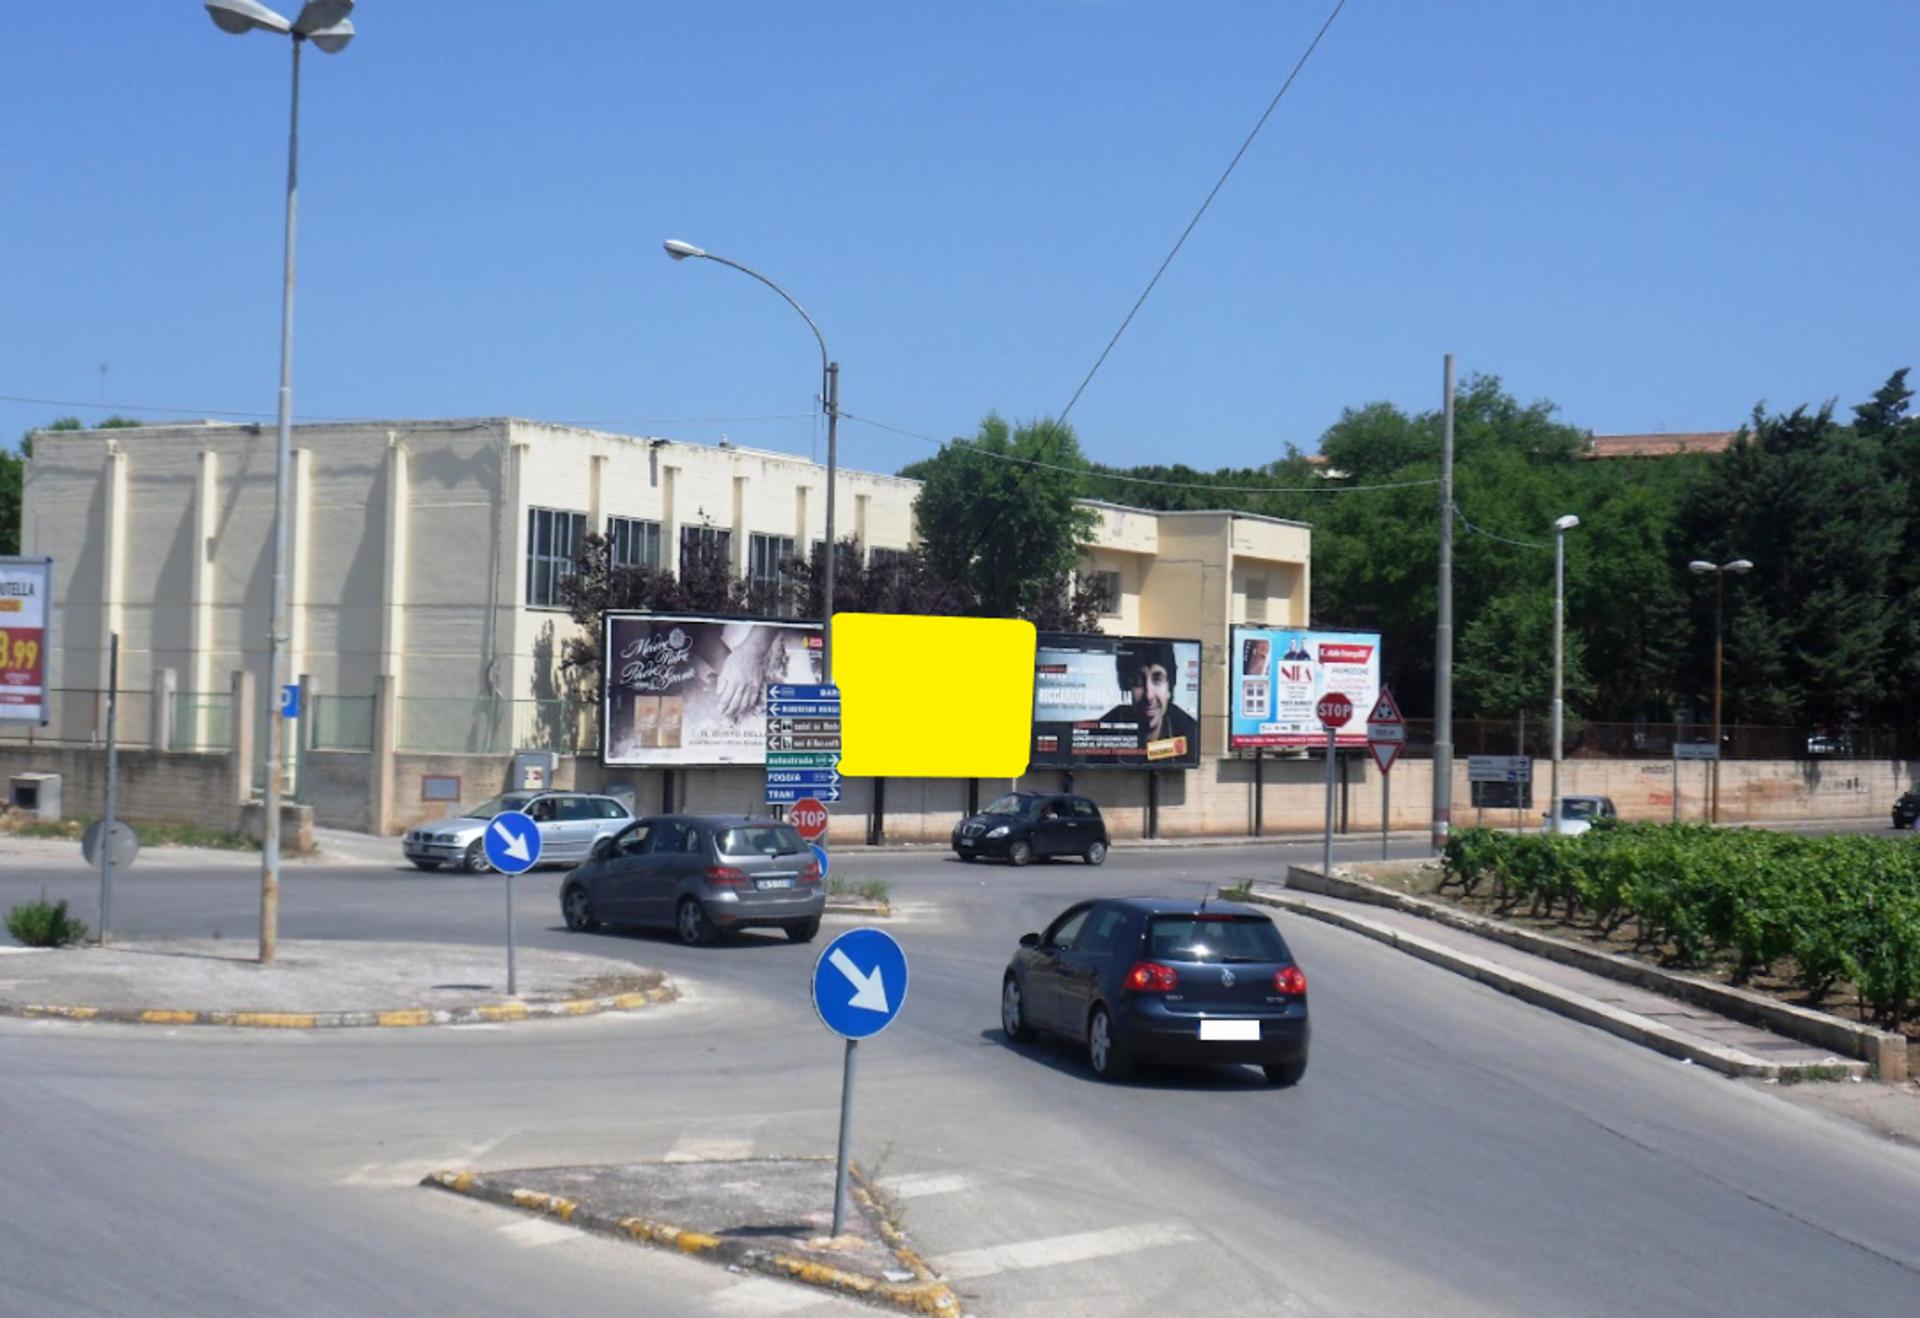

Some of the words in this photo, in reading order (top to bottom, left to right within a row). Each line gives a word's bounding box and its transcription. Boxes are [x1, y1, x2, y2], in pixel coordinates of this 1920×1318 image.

[1319, 703, 1351, 718] STOP
[768, 756, 813, 764] autostrada
[768, 773, 801, 782] FOGGIA
[768, 790, 794, 798] TRANI
[791, 810, 826, 827] STOP
